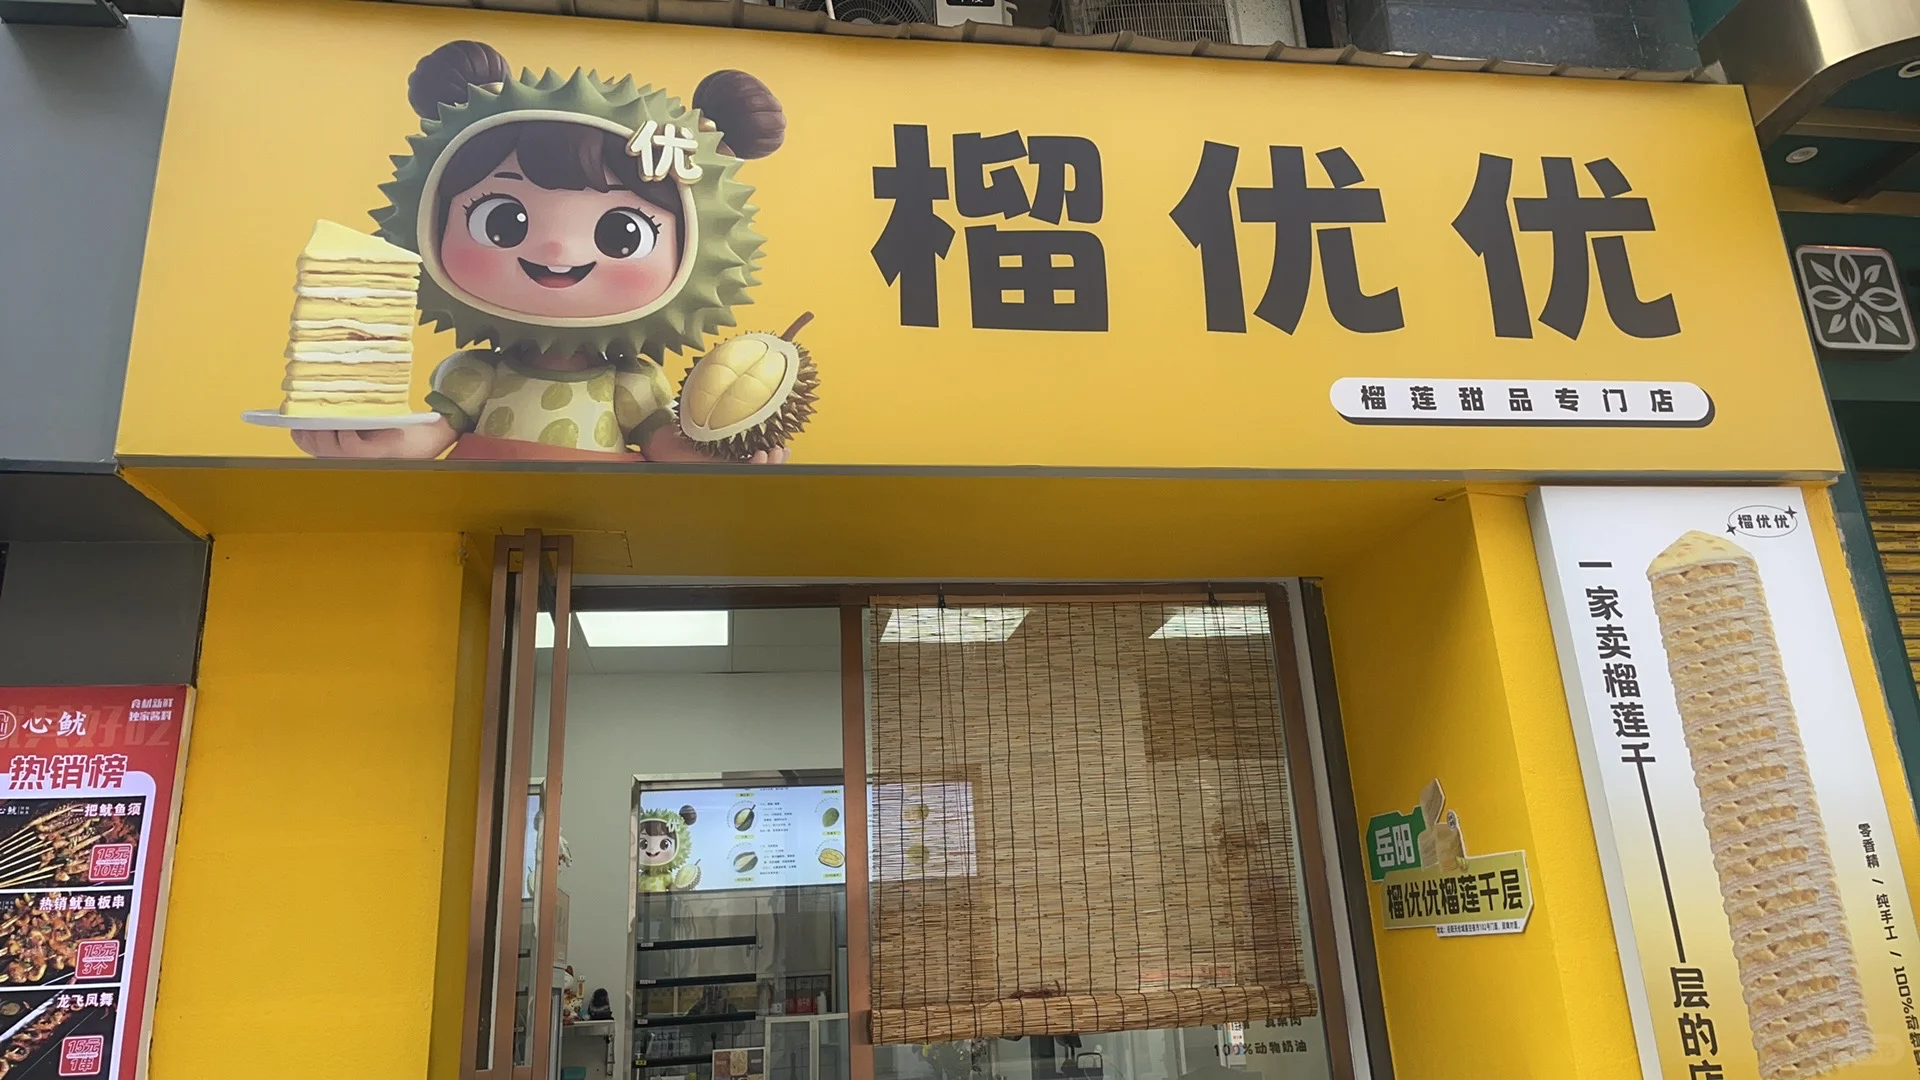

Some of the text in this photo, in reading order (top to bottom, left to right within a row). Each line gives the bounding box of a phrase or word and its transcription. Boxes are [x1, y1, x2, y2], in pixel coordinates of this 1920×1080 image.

[629, 120, 703, 180] 优
[870, 124, 1681, 341] 榴优优
[1361, 385, 1673, 413] 榴莲甜品专门店
[1738, 513, 1790, 530] 榴优优
[22, 710, 87, 737] 心鱿
[8, 753, 128, 791] 热销榜
[71, 802, 142, 817] 一把鱿鱼须
[97, 847, 130, 860] 15元
[1375, 823, 1415, 868] 岳阳
[93, 864, 126, 877] 10串
[1387, 869, 1523, 919] 榴优优榴莲千层
[39, 895, 125, 911] 热销鱿鱼板串
[84, 943, 117, 957] 15元
[81, 960, 108, 975] 3个
[56, 992, 114, 1008] 龙飞凤舞
[67, 1039, 101, 1053] 15元
[70, 1058, 94, 1071] 1串
